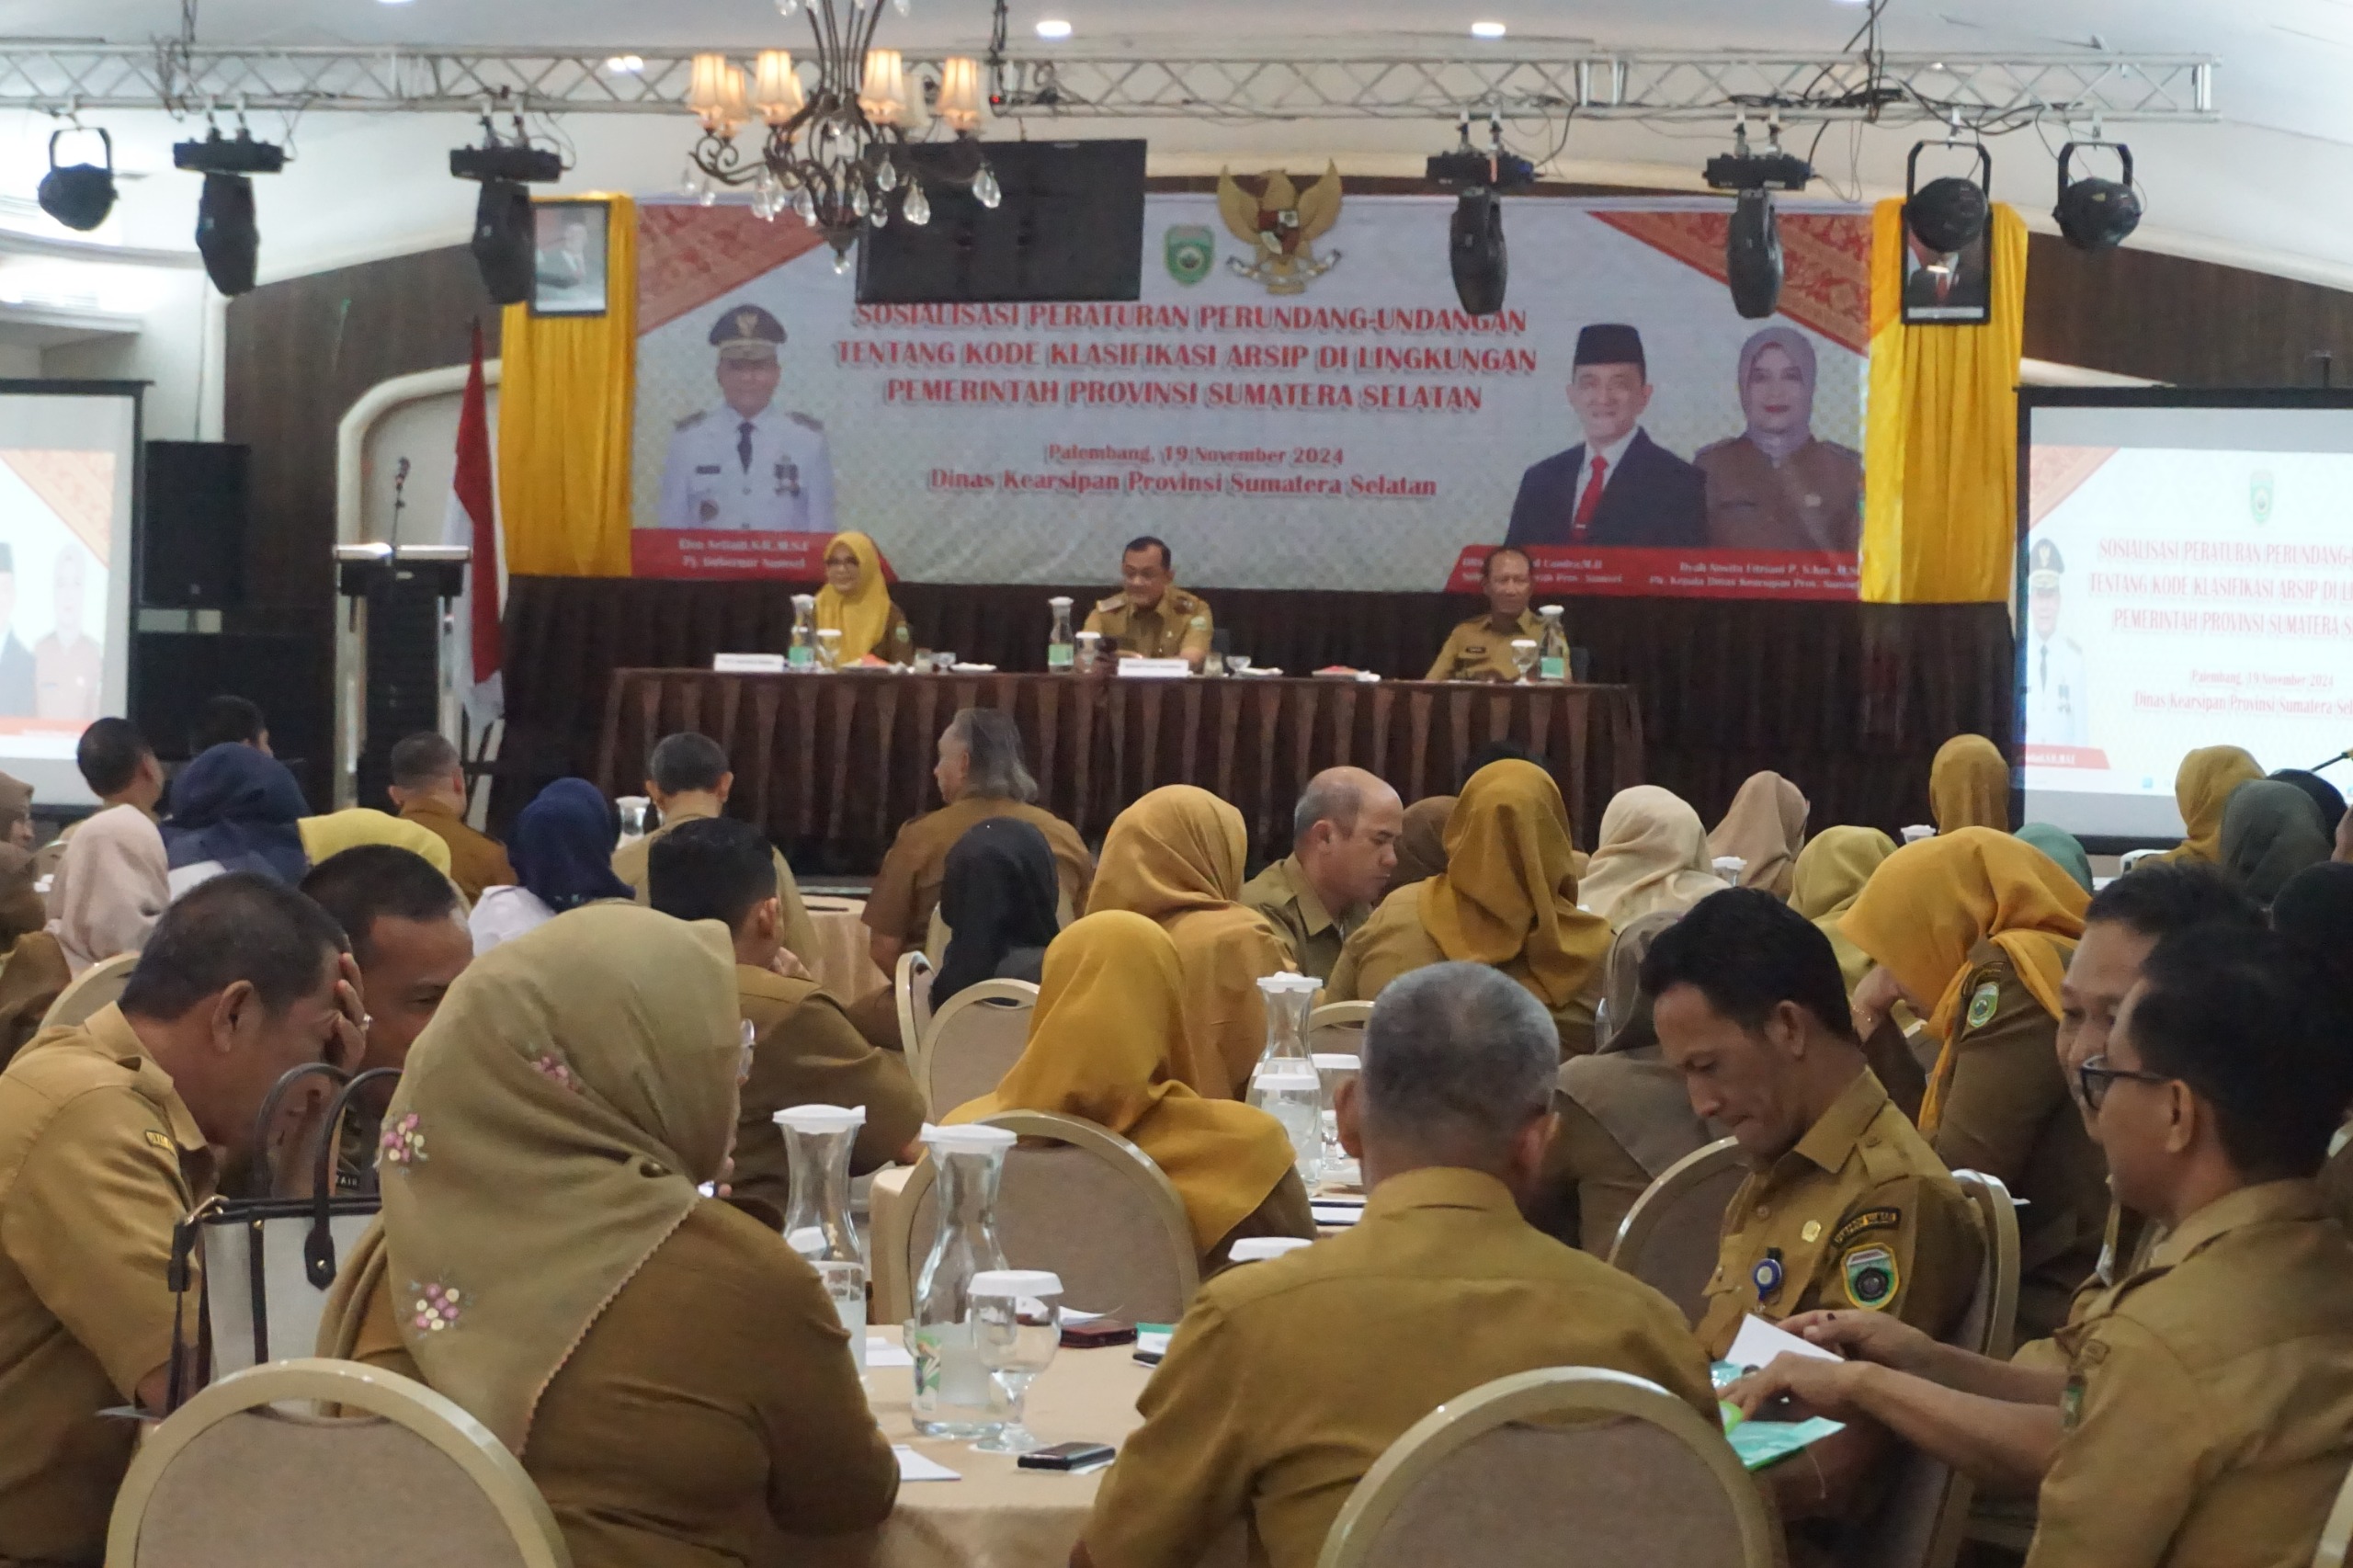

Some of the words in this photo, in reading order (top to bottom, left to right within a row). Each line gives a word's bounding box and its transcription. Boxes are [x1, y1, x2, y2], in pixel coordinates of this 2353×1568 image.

[857, 303, 1019, 326] SOSIALISASI
[1029, 304, 1189, 328] PERATURAN
[1199, 306, 1527, 333] PERUNDANG-UNDANGAN
[837, 341, 955, 364] TENTANG
[965, 342, 1040, 365] KODE
[1050, 343, 1216, 367] KLASIFIKASI
[1227, 345, 1309, 369] ARSIP
[1320, 347, 1347, 369] DI
[1359, 347, 1537, 372] LINGKUNGAN
[887, 380, 1059, 403] PEMERINTAH
[1069, 381, 1198, 404] PROVINSI
[1208, 382, 1353, 407] SUMATERA
[1363, 385, 1483, 409] SELATAN
[1164, 445, 1188, 462] 19
[1195, 446, 1286, 464] November
[1292, 447, 1345, 465] 2024
[931, 469, 995, 488] Dinas
[1004, 470, 1120, 494] Kearsipan
[1128, 470, 1222, 492] Provinsi
[1230, 472, 1342, 494] Sumatera
[1350, 474, 1437, 496] Selatan
[2099, 538, 2179, 560] SOSIALISASI
[2184, 540, 2261, 562] PERATURAN
[2089, 573, 2148, 595] TENTANG
[2153, 575, 2189, 596] KODE
[2193, 576, 2274, 598] KLASIFIKASI
[2279, 578, 2318, 600] ARSIP
[2323, 580, 2337, 601] DI
[2114, 608, 2198, 631] PEMERINTAH
[2202, 611, 2264, 633] PROVINSI
[2268, 613, 2339, 636] SUMATERA
[2248, 672, 2260, 685] 19
[2309, 673, 2335, 687] 2024
[2133, 691, 2166, 709] Dinas
[2169, 692, 2227, 713] Kearsipan
[2230, 695, 2276, 713] Provinsi
[2279, 696, 2333, 716] Sumatera
